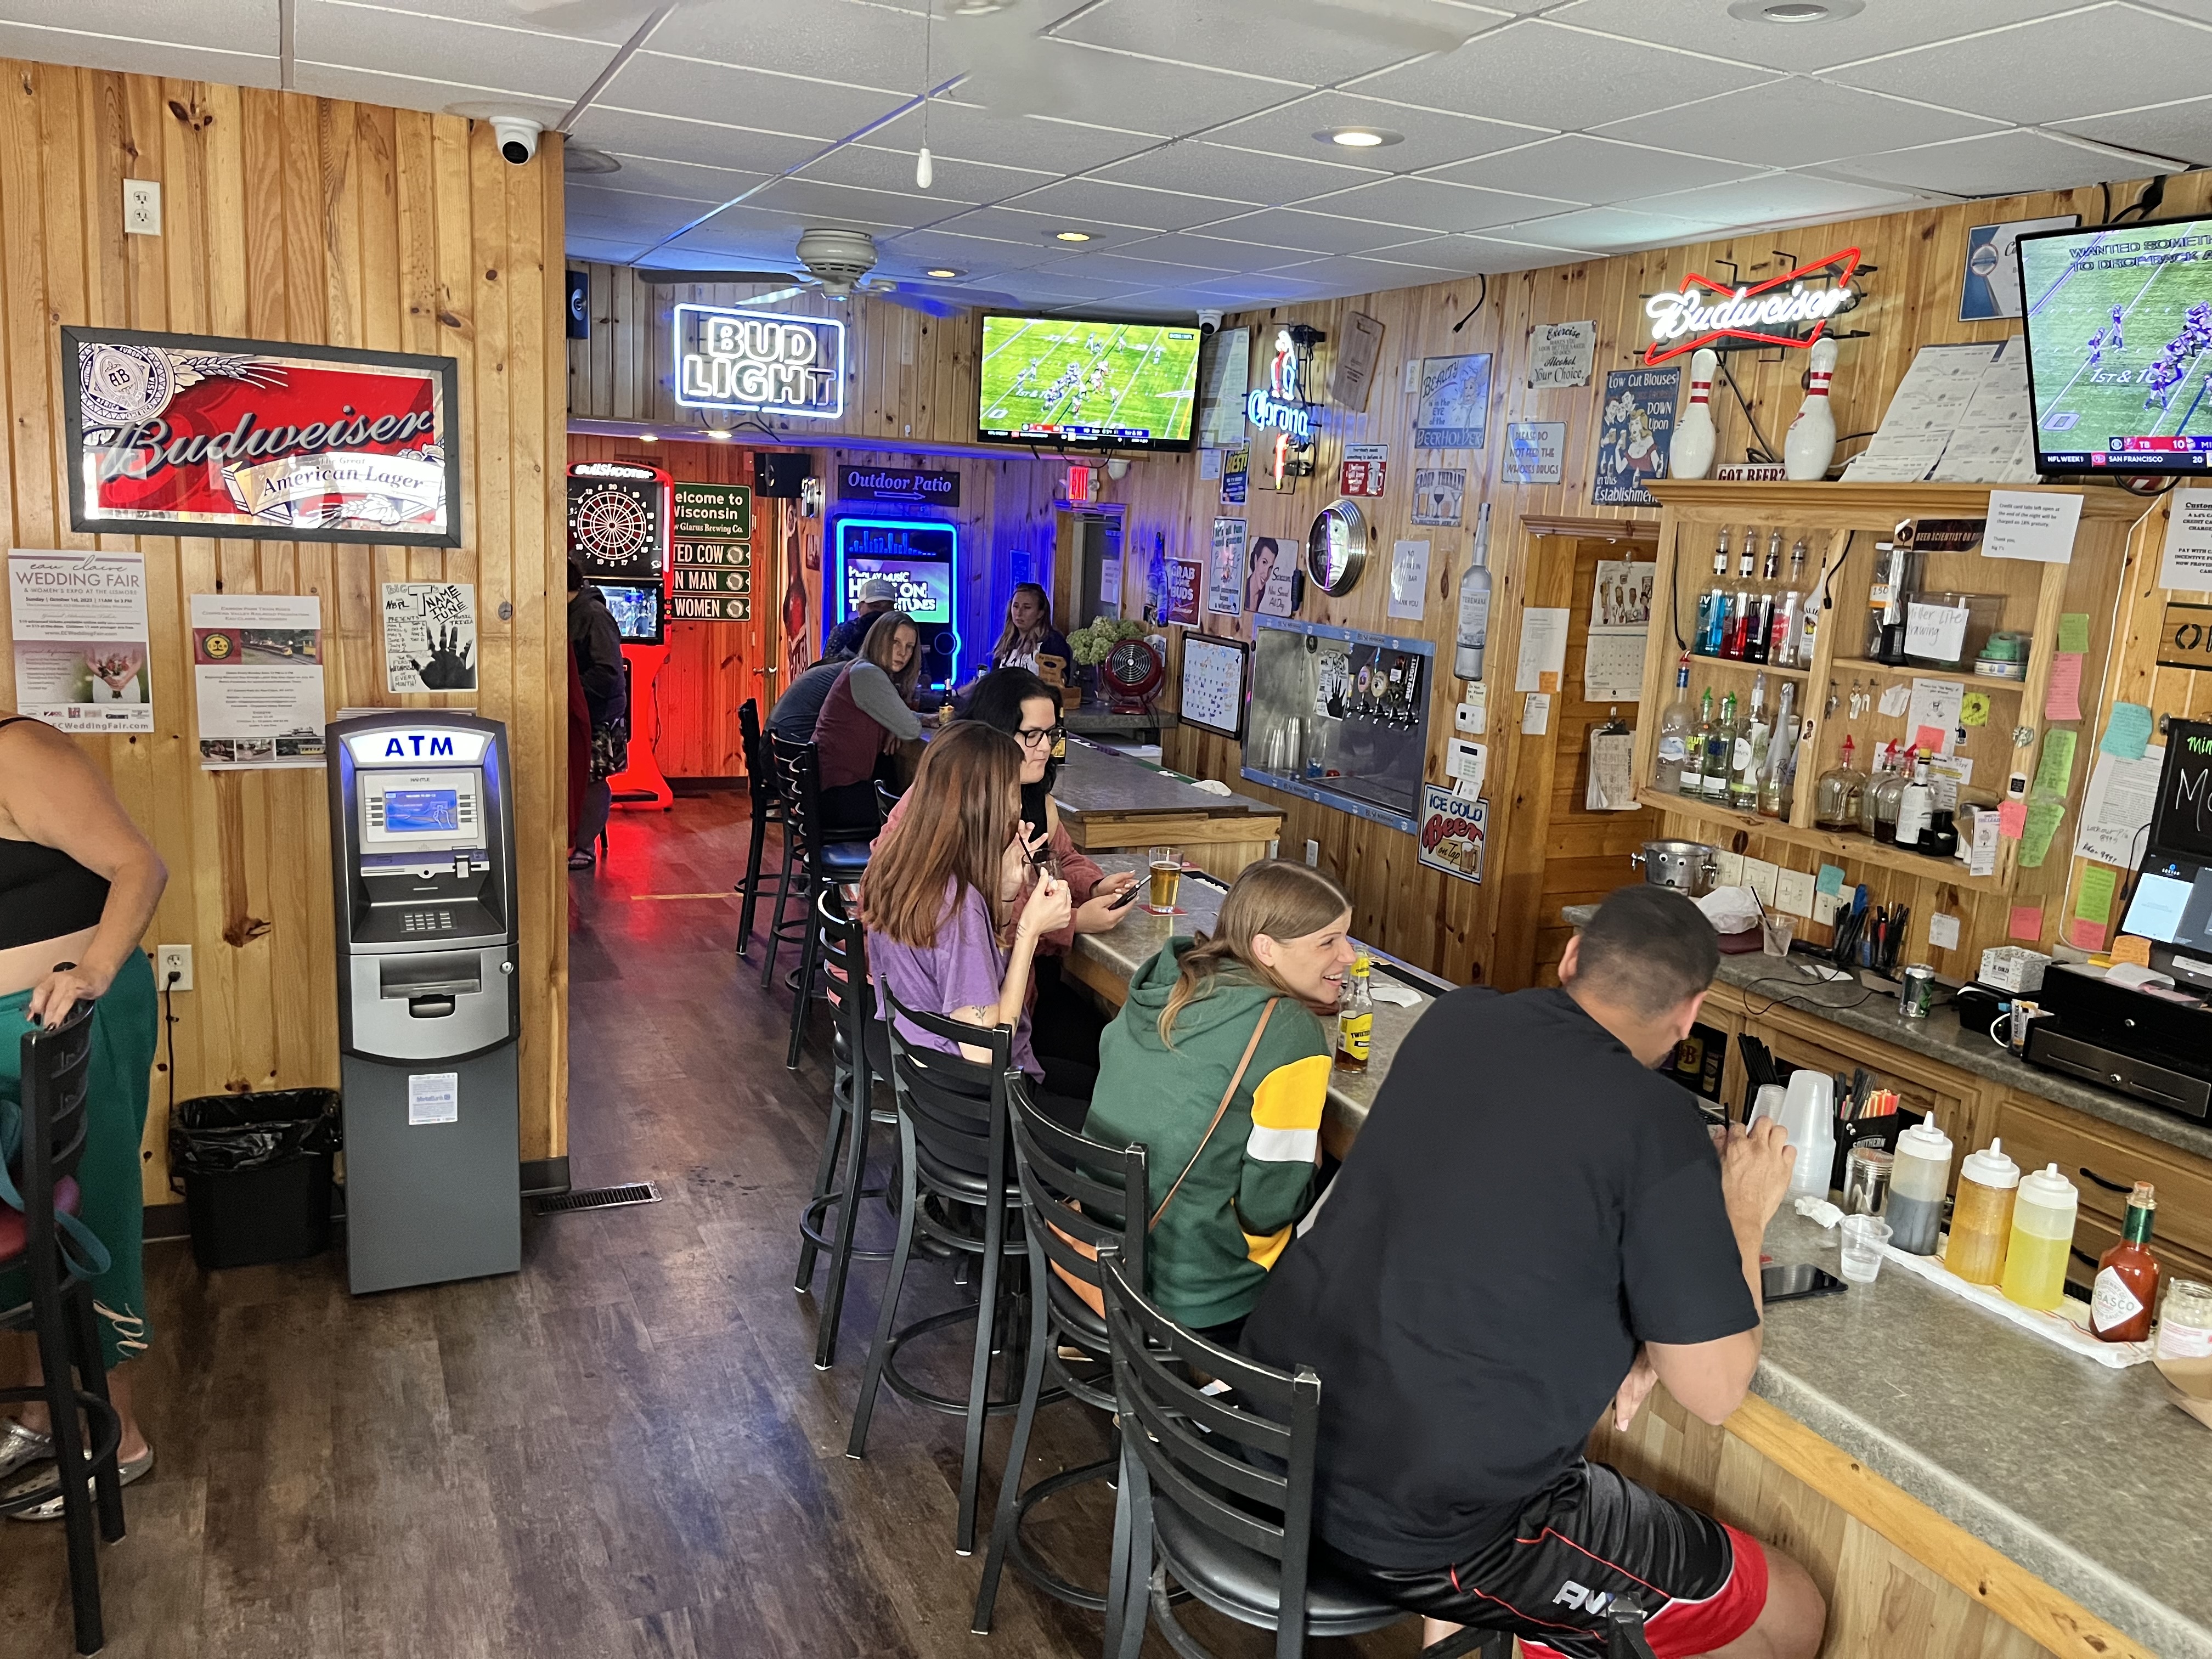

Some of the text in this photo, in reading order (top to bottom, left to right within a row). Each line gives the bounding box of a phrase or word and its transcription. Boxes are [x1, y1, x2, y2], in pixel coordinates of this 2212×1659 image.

[2070, 242, 2140, 257] WANTED
[2070, 261, 2094, 272] TO
[1646, 284, 1852, 340] Budweiser
[708, 317, 816, 365] BUD
[1547, 326, 1580, 340] Exercise
[683, 354, 837, 406] LIGHT
[1423, 360, 1459, 398] BEAUTY
[1554, 367, 1584, 382] Choice.
[1609, 373, 1677, 388] Low Cut Blouses
[2117, 370, 2132, 383] &
[95, 398, 120, 411] AFRICA
[1248, 388, 1310, 437] Corona
[1432, 408, 1444, 416] EYE
[1647, 402, 1672, 415] DOWN
[1649, 419, 1669, 431] Upon
[83, 404, 432, 481] Budweiser
[1417, 430, 1482, 446] BEERHOLDER
[2139, 439, 2185, 449] TB 10
[1542, 448, 1555, 458] THE
[1536, 465, 1559, 474] DRUGS
[1719, 469, 1742, 481] GOT
[262, 464, 424, 496] American Lager
[848, 471, 952, 493] Outdoor Patio
[675, 491, 743, 506] elcome to
[1595, 487, 1658, 502] Establishmen
[680, 522, 743, 535] Glarus Brewing Co.
[1915, 532, 1931, 541] BEER
[1931, 532, 1962, 541] SCIENTIST
[1962, 532, 1971, 541] ON
[697, 545, 725, 563] COW
[72, 554, 128, 572] claire
[15, 571, 140, 587] WEDDING FAIR
[689, 571, 717, 590] MAN
[883, 572, 910, 582] MUSIC
[386, 584, 408, 595] BIG
[426, 585, 459, 608] NAME
[1170, 586, 1193, 601] BUDS
[429, 592, 461, 616] THAT
[432, 601, 466, 622] TUNE
[675, 599, 720, 617] WOMEN
[1408, 658, 1417, 681] LIGHT
[385, 735, 454, 757] ATM
[1429, 793, 1482, 822] ICE COLD
[1423, 813, 1483, 855] Beer
[1437, 842, 1460, 865] on Tap
